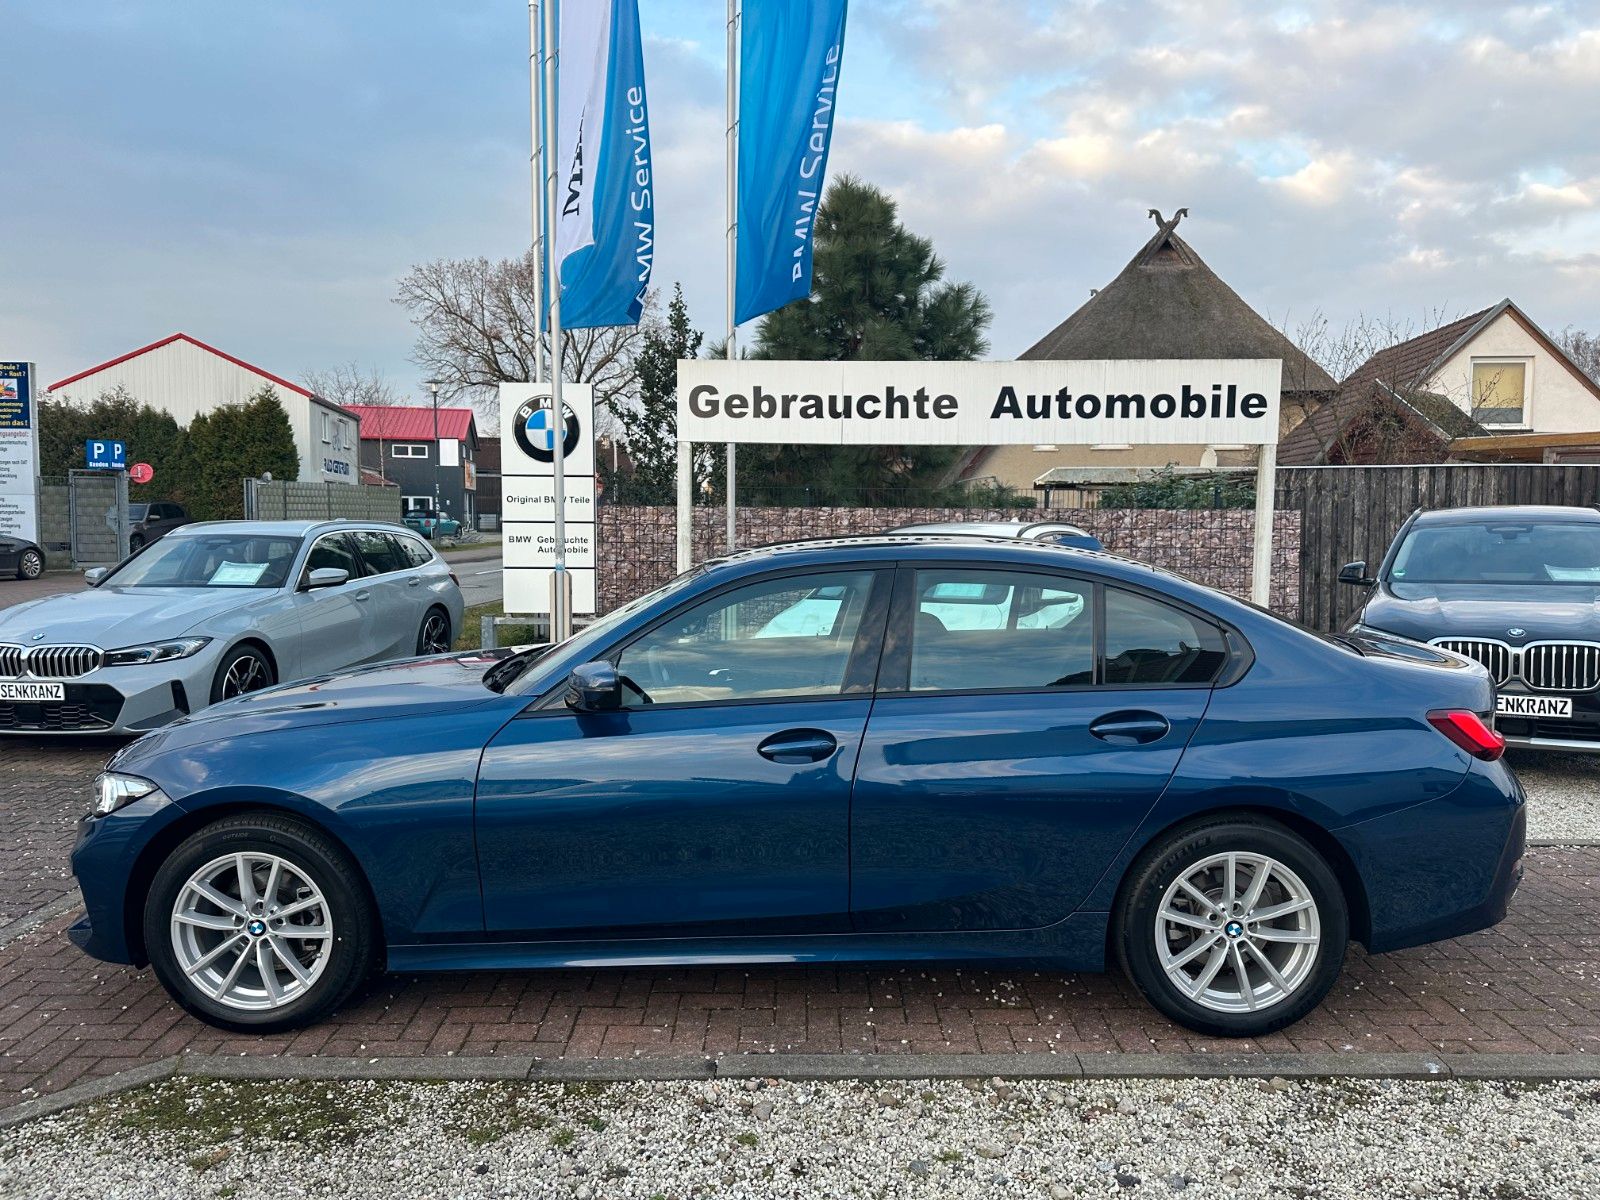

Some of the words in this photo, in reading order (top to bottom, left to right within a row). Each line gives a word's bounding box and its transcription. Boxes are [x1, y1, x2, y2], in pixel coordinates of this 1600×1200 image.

[799, 44, 840, 179] Service
[626, 86, 651, 211] Service
[519, 398, 574, 419] BMW
[688, 384, 959, 419] Gebrauchte
[990, 384, 1268, 419] Automobile
[506, 496, 541, 504] Original
